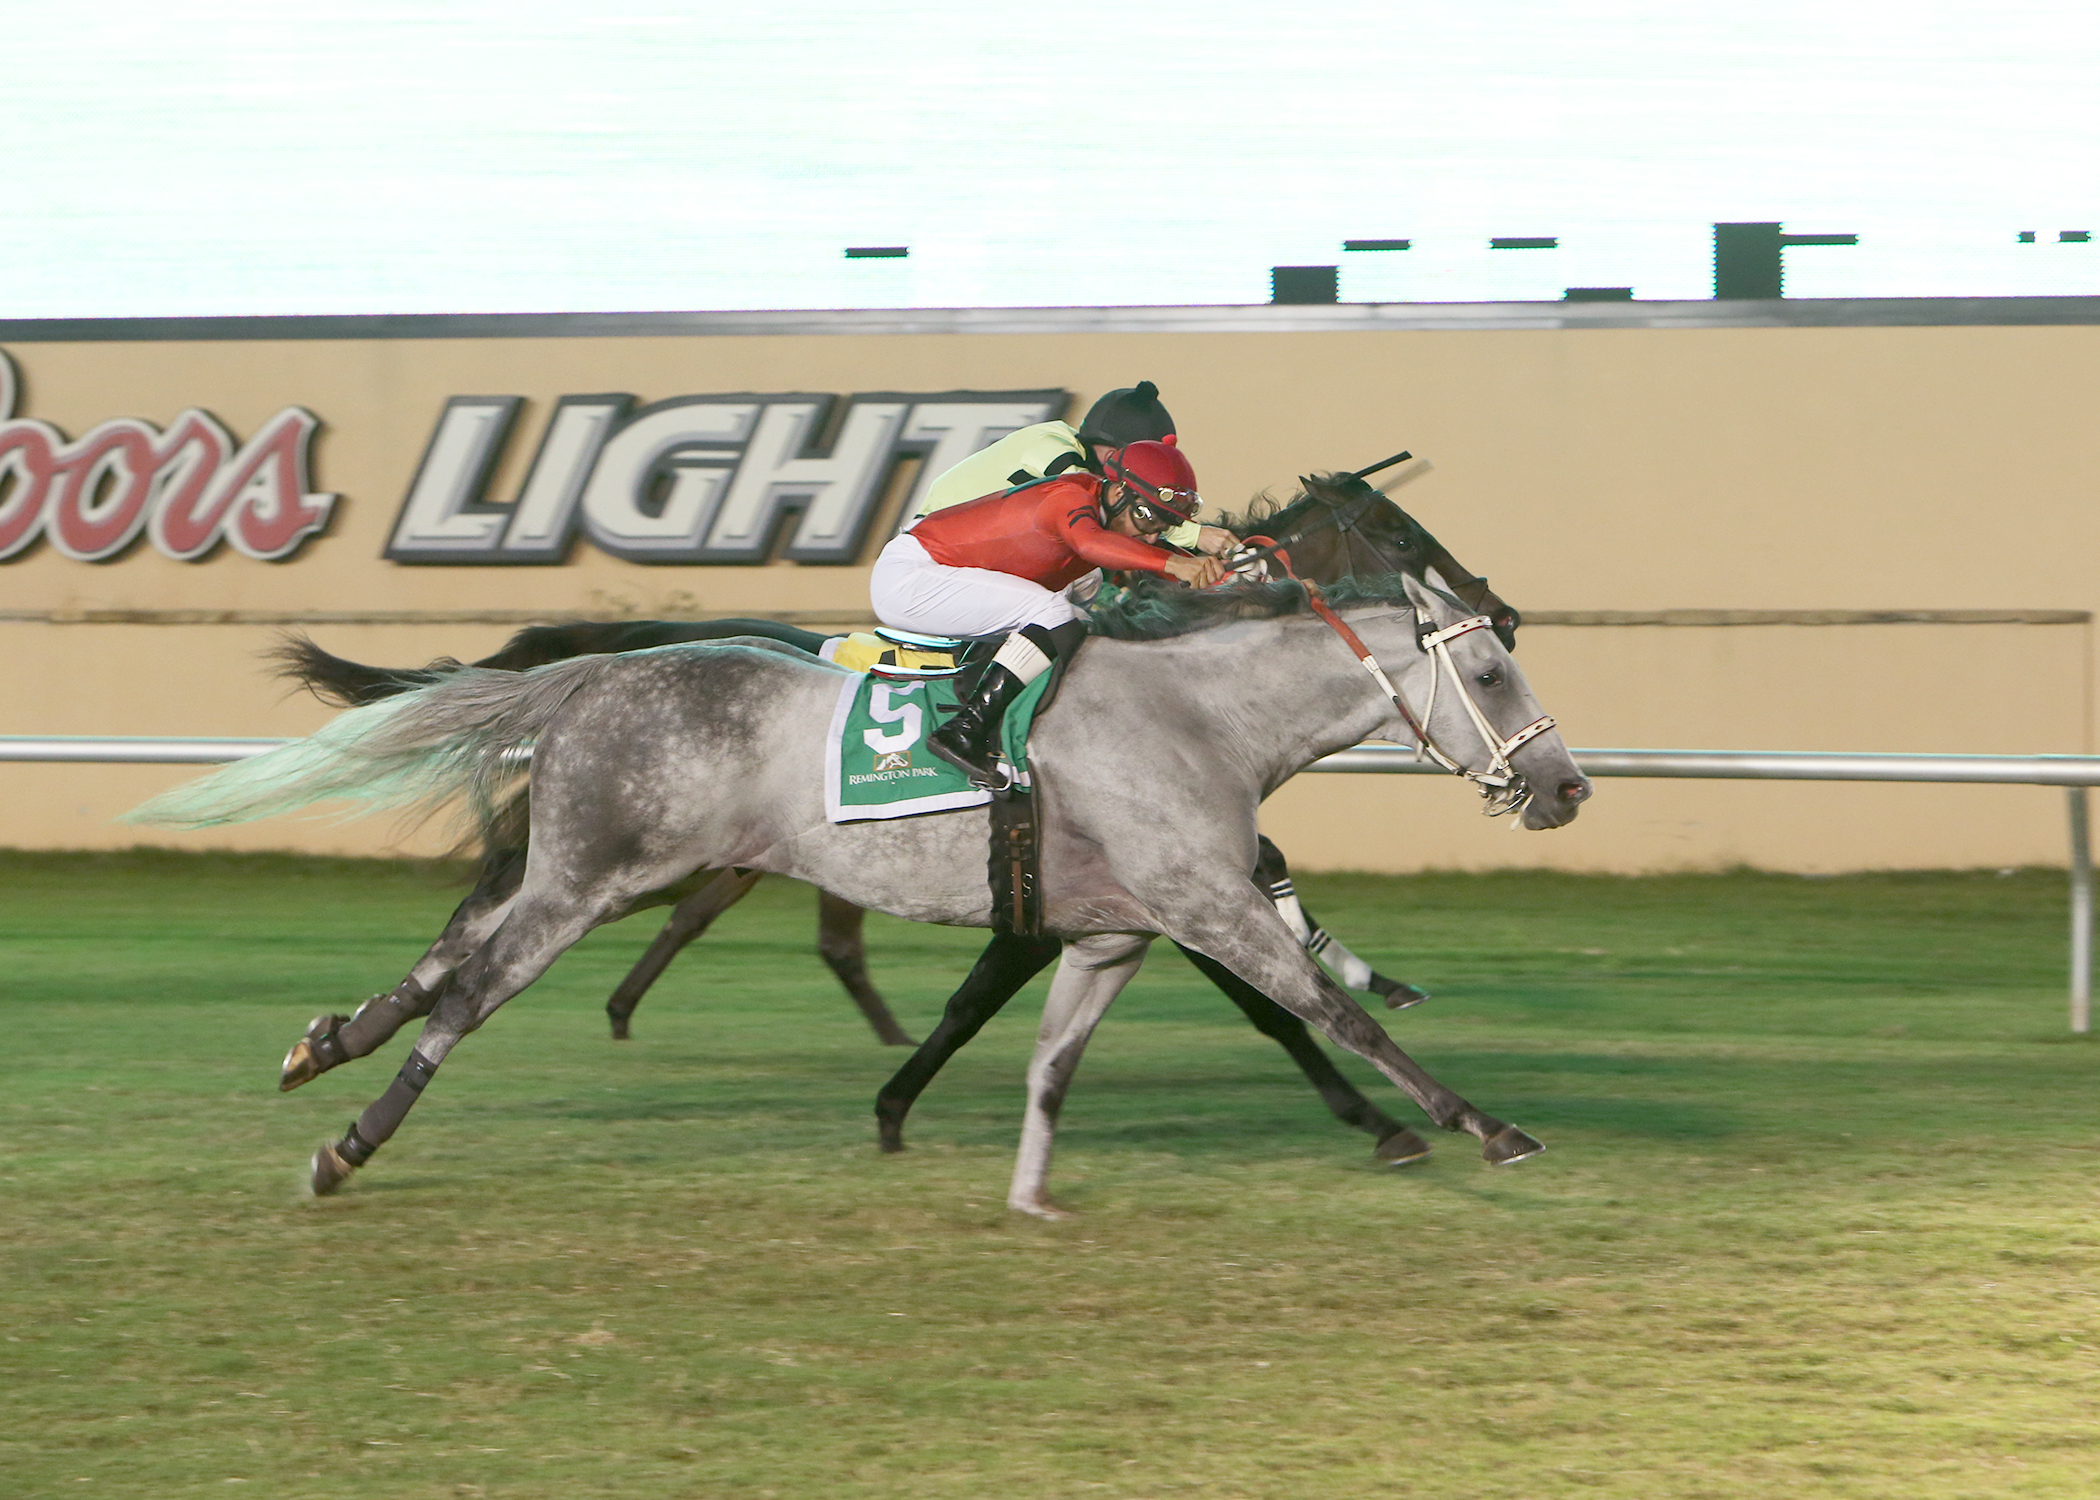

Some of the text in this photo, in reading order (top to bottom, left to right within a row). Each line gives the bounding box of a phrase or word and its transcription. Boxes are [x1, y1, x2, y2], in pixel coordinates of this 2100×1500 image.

[0, 348, 1071, 565] oors LIGHT
[863, 680, 926, 755] 5
[849, 767, 938, 785] REMINGTON PARK
